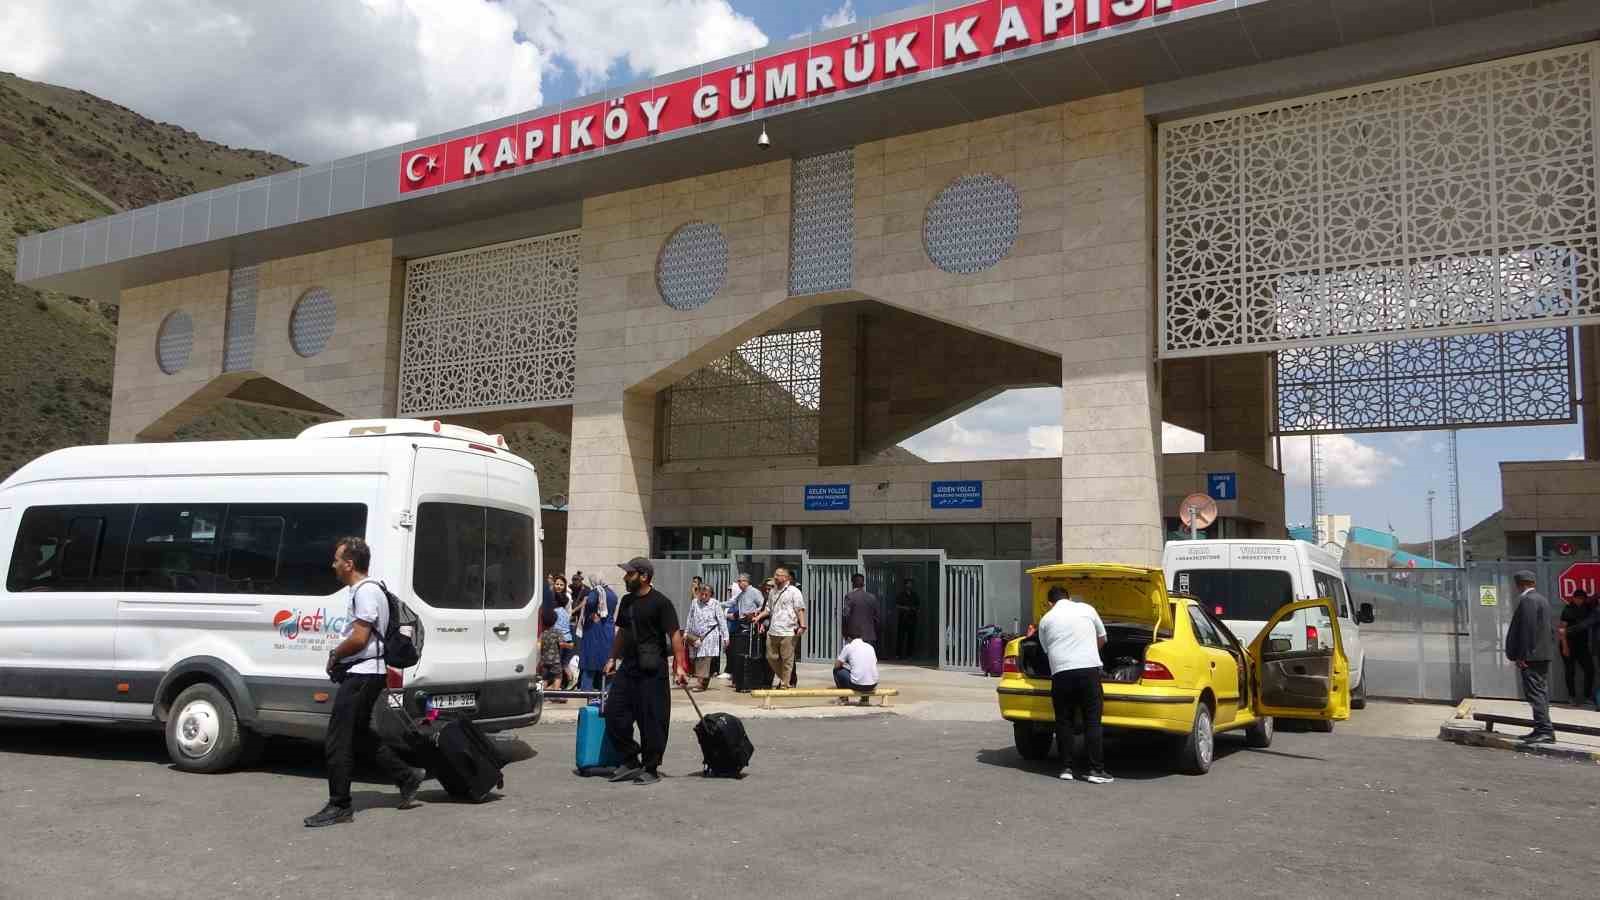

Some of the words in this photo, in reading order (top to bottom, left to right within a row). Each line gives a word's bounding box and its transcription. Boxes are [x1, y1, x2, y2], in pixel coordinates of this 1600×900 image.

[463, 97, 668, 174] KAPIKÖY
[692, 33, 920, 118] GÜMRÜK
[944, 0, 1173, 60] KAPI
[1216, 482, 1226, 498] 1
